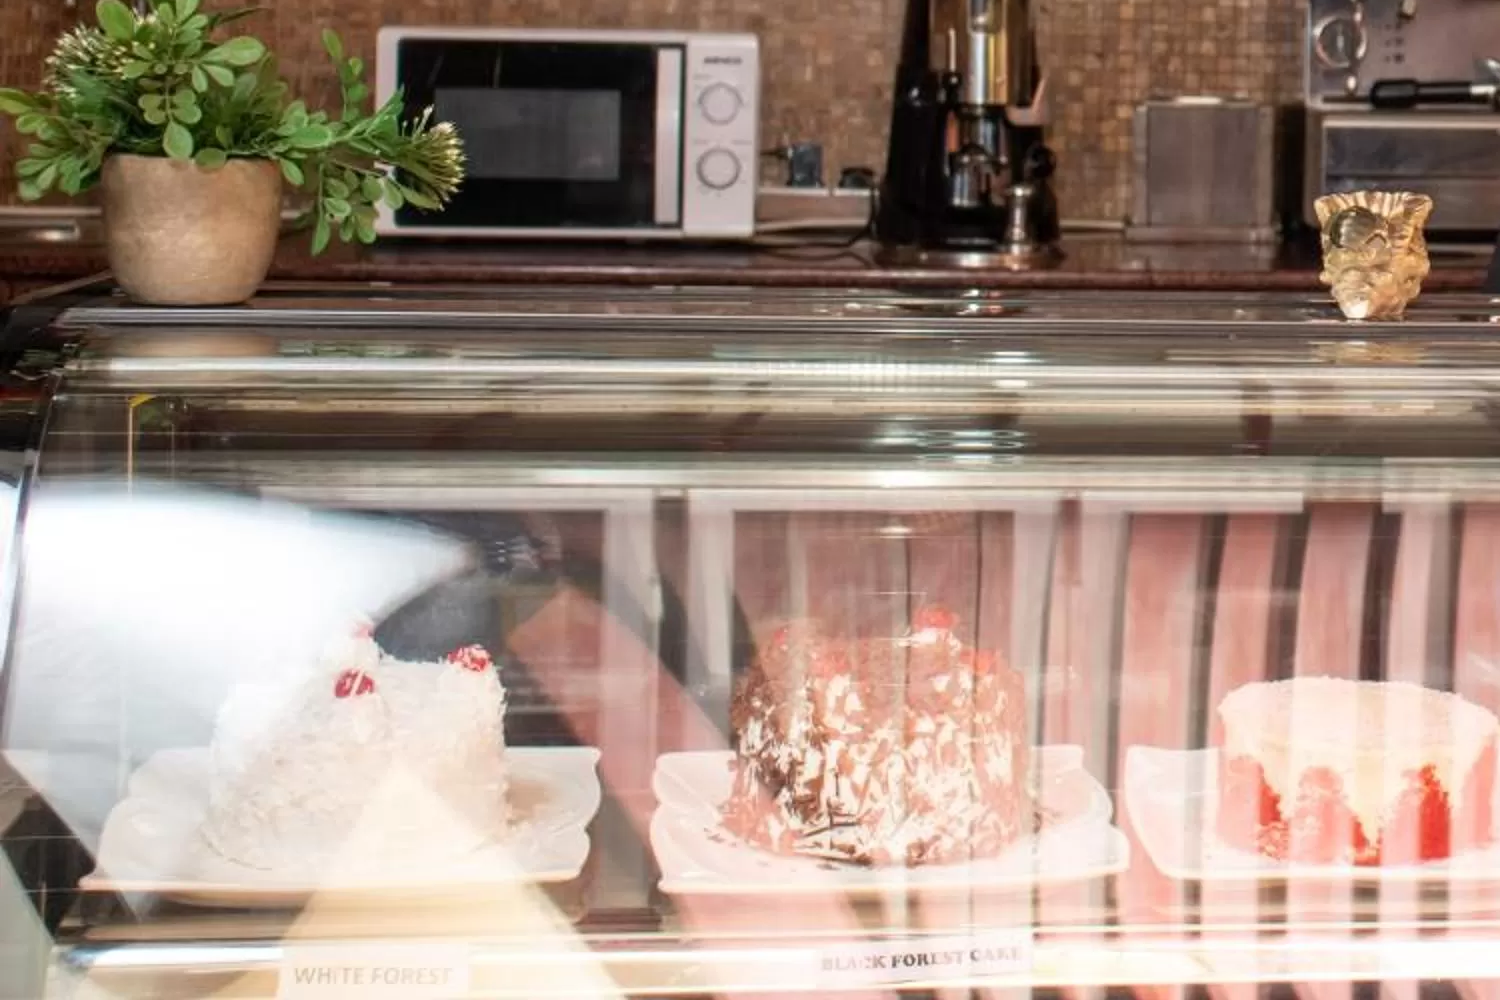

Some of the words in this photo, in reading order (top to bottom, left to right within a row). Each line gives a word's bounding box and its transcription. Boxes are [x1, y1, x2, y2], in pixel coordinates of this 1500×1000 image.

[891, 949, 963, 968] FOREST
[295, 967, 365, 985] WHITE
[370, 967, 455, 985] FOREST
